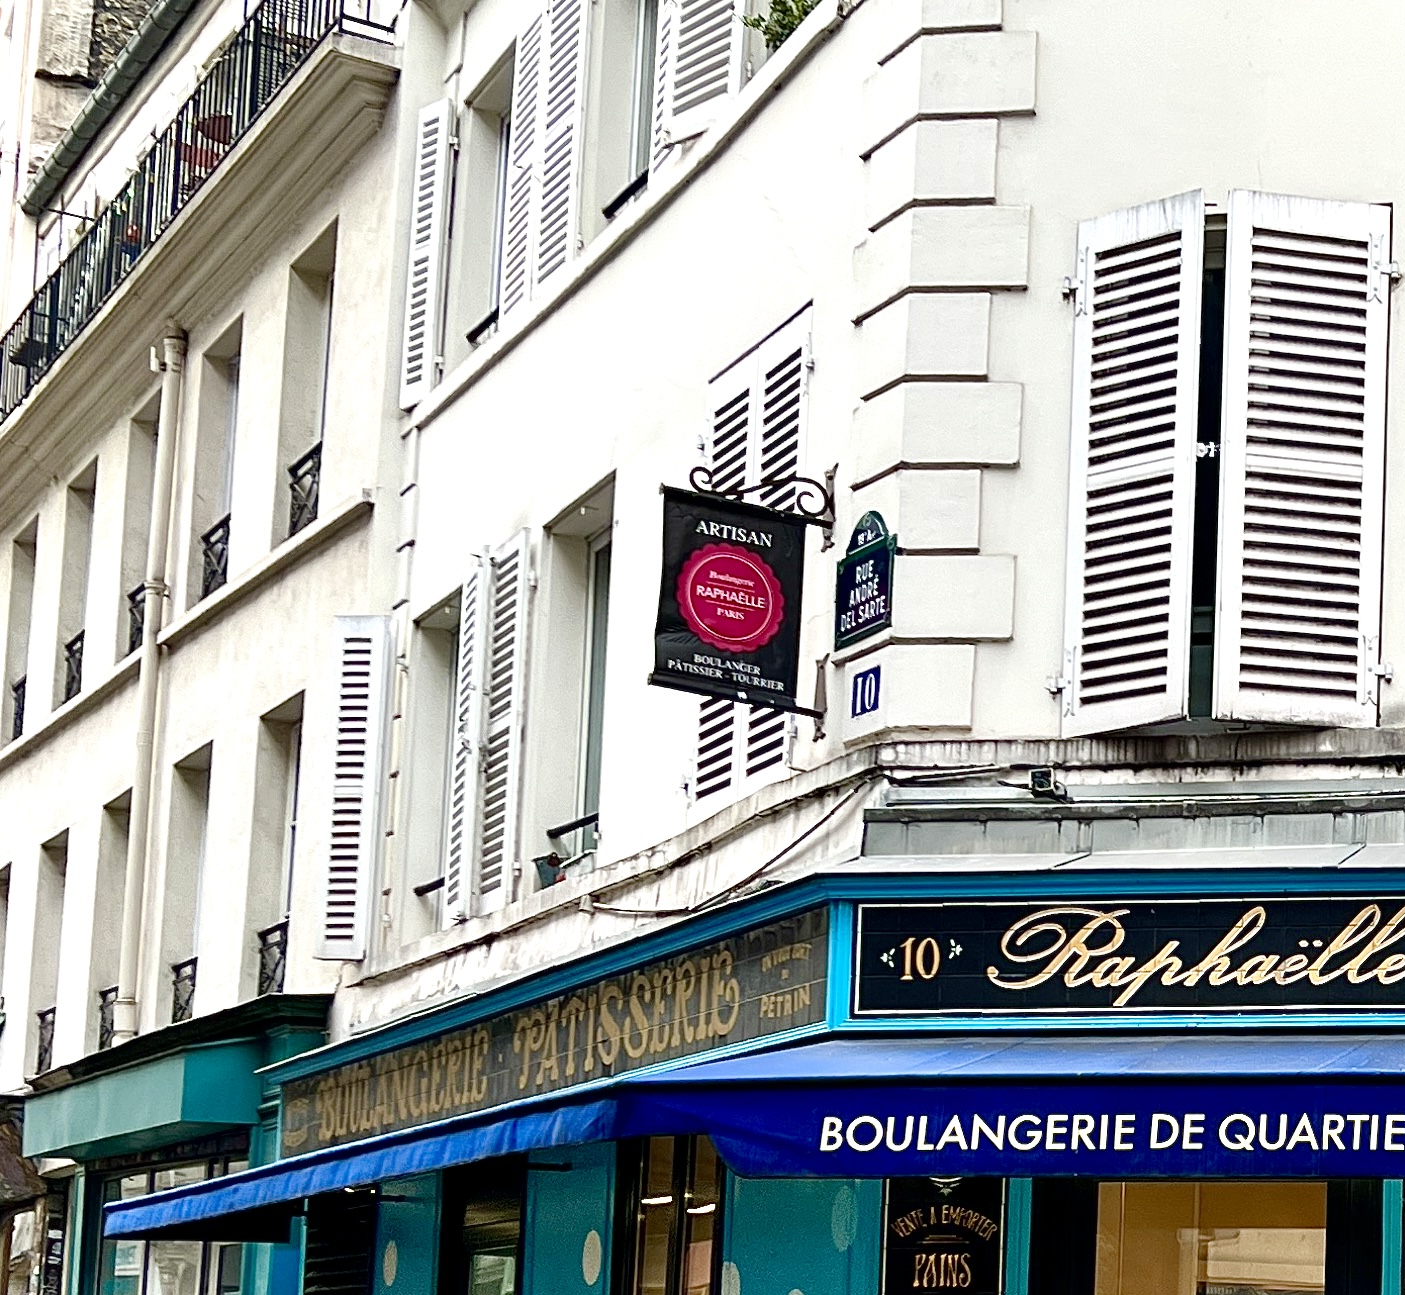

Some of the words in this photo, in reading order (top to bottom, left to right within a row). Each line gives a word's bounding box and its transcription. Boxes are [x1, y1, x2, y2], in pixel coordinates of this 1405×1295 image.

[696, 520, 773, 548] ARTISAN
[856, 560, 874, 584] RUE
[696, 585, 765, 608] RAPHAËLLE
[849, 573, 879, 607] ANDRÉ
[717, 607, 744, 620] PARIS
[840, 609, 857, 632] DEL
[857, 595, 885, 623] SARTE
[667, 658, 723, 680] PÂTISSIER
[732, 671, 784, 691] TOURRIER
[693, 654, 761, 676] BOULANGER
[856, 673, 876, 714] 10
[900, 937, 940, 981] 10
[316, 1029, 489, 1142] BOULANGERIE
[513, 949, 741, 1090] PATISSERIE
[820, 1113, 1135, 1152] BOULANGERIE
[1150, 1113, 1205, 1151] DE
[890, 1208, 927, 1238] VENTE
[941, 1204, 998, 1241] EMPORTER
[913, 1253, 971, 1288] PAINS
